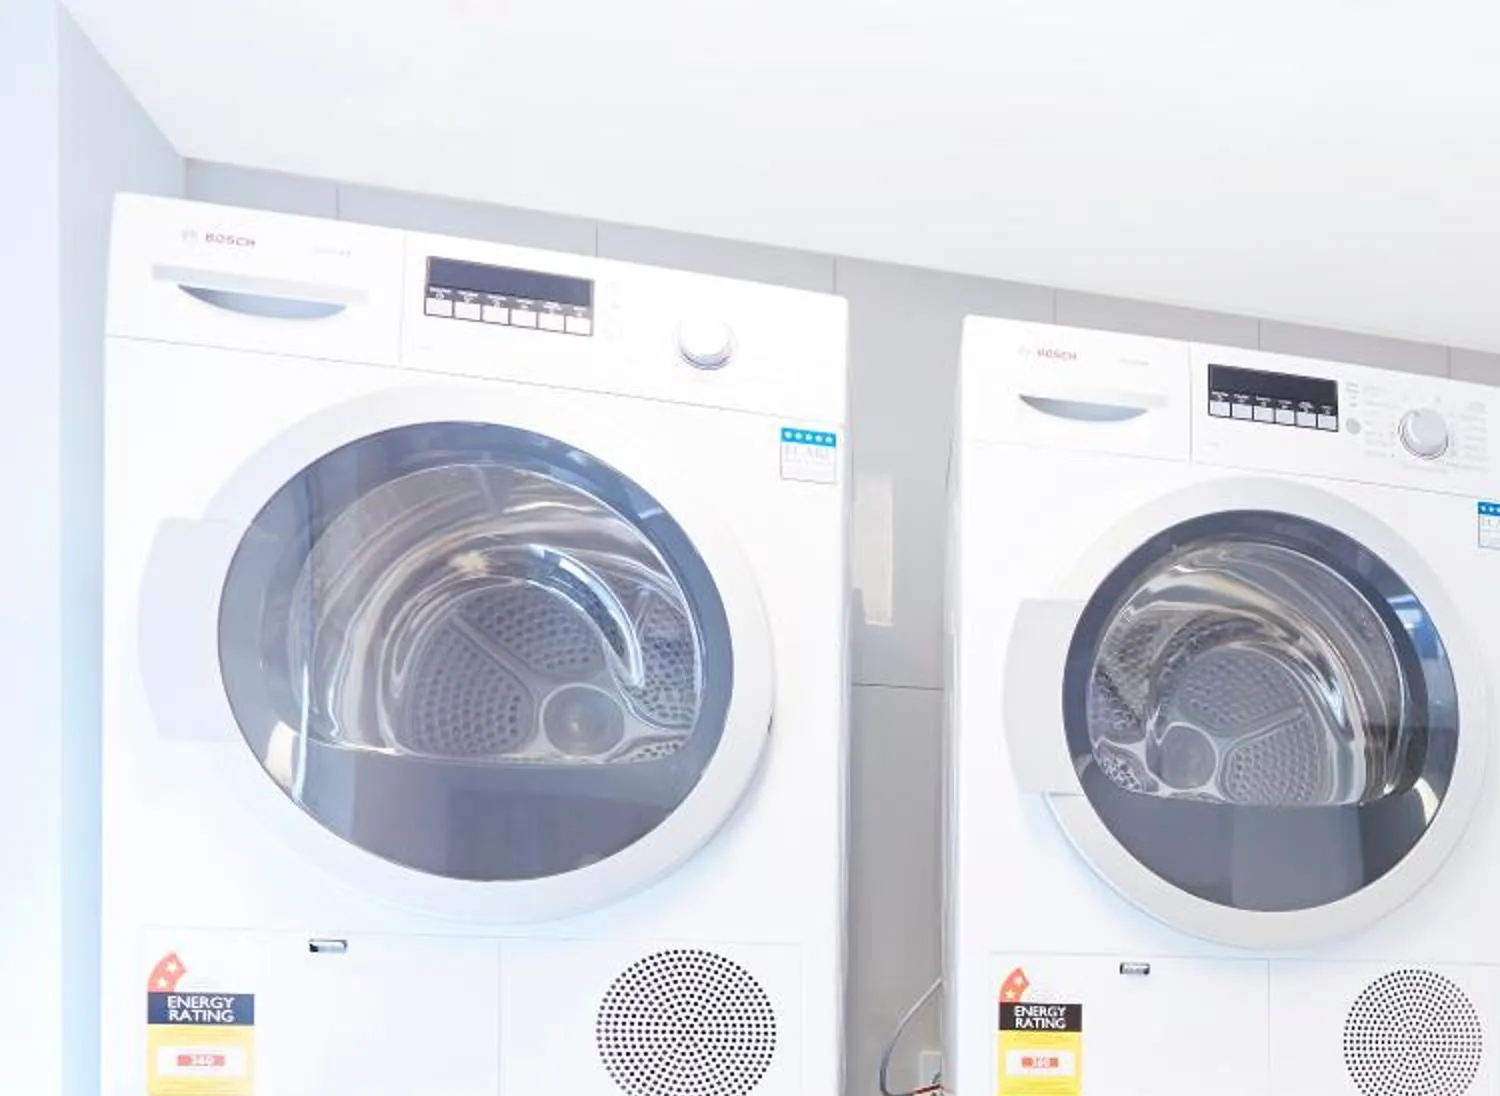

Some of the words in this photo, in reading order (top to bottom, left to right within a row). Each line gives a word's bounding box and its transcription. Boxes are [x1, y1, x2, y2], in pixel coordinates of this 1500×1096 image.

[205, 231, 256, 248] BOSCH
[1036, 348, 1078, 361] BOSCH
[166, 995, 235, 1009] ENERGY
[168, 1009, 235, 1023] RATING
[1013, 1005, 1067, 1018] ENERGY
[1014, 1017, 1067, 1029] RATING
